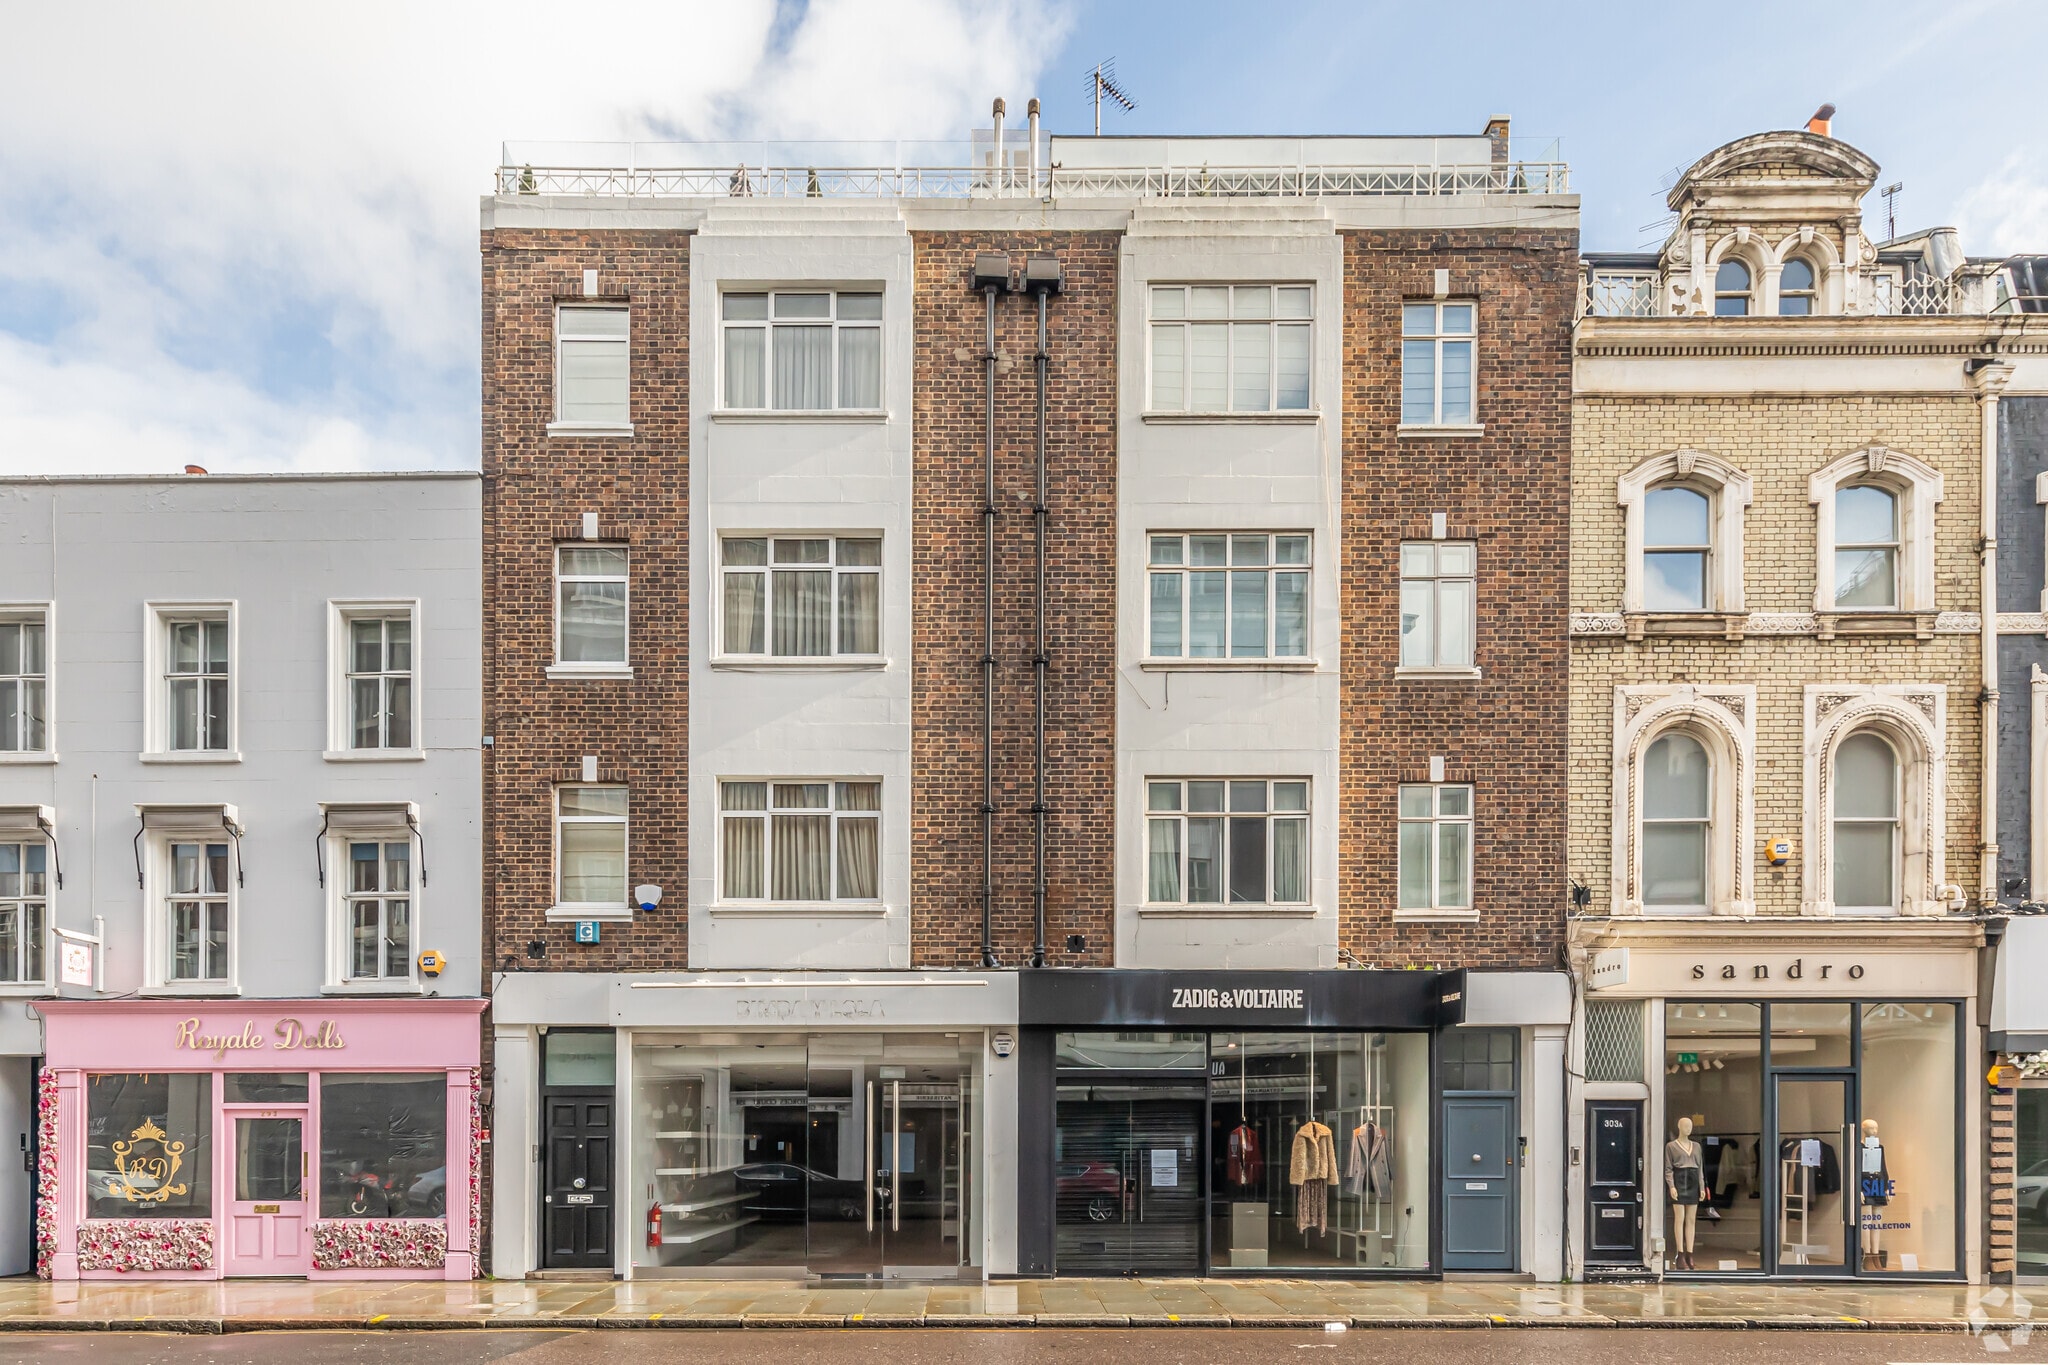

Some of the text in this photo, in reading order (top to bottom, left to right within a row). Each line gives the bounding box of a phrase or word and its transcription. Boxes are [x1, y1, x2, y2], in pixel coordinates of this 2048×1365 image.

[1692, 958, 1865, 980] sandro
[1172, 988, 1304, 1009] ZADIG&VOLTAIRE
[175, 1017, 346, 1062] Royale Dolls
[1604, 1119, 1623, 1128] 303A
[1862, 1179, 1896, 1197] SALE
